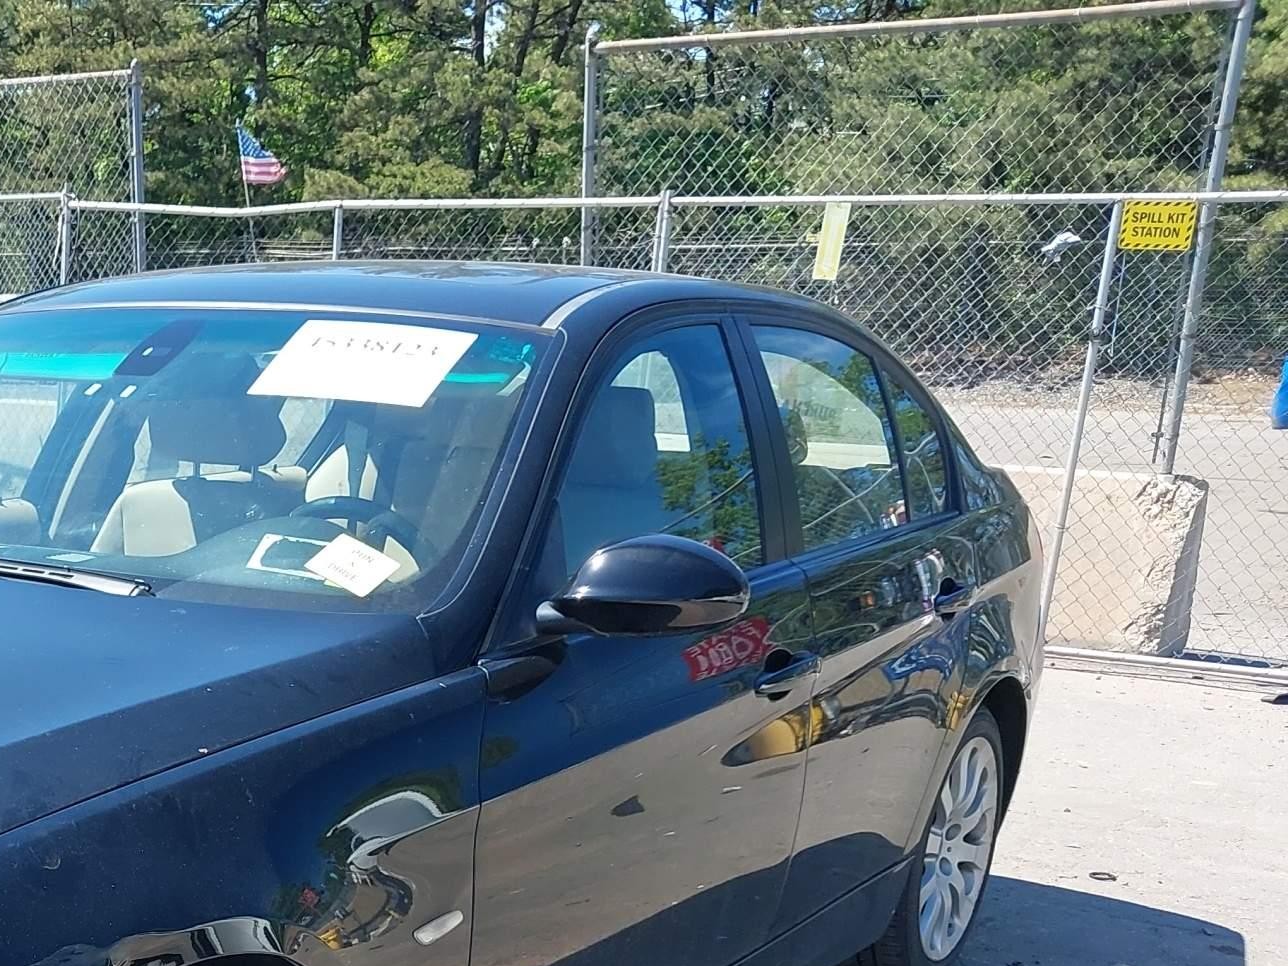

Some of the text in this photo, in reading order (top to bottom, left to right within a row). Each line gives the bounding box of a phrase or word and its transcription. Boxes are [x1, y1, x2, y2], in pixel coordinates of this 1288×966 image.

[1131, 211, 1187, 224] SPILL KIT
[1131, 226, 1181, 239] STATION
